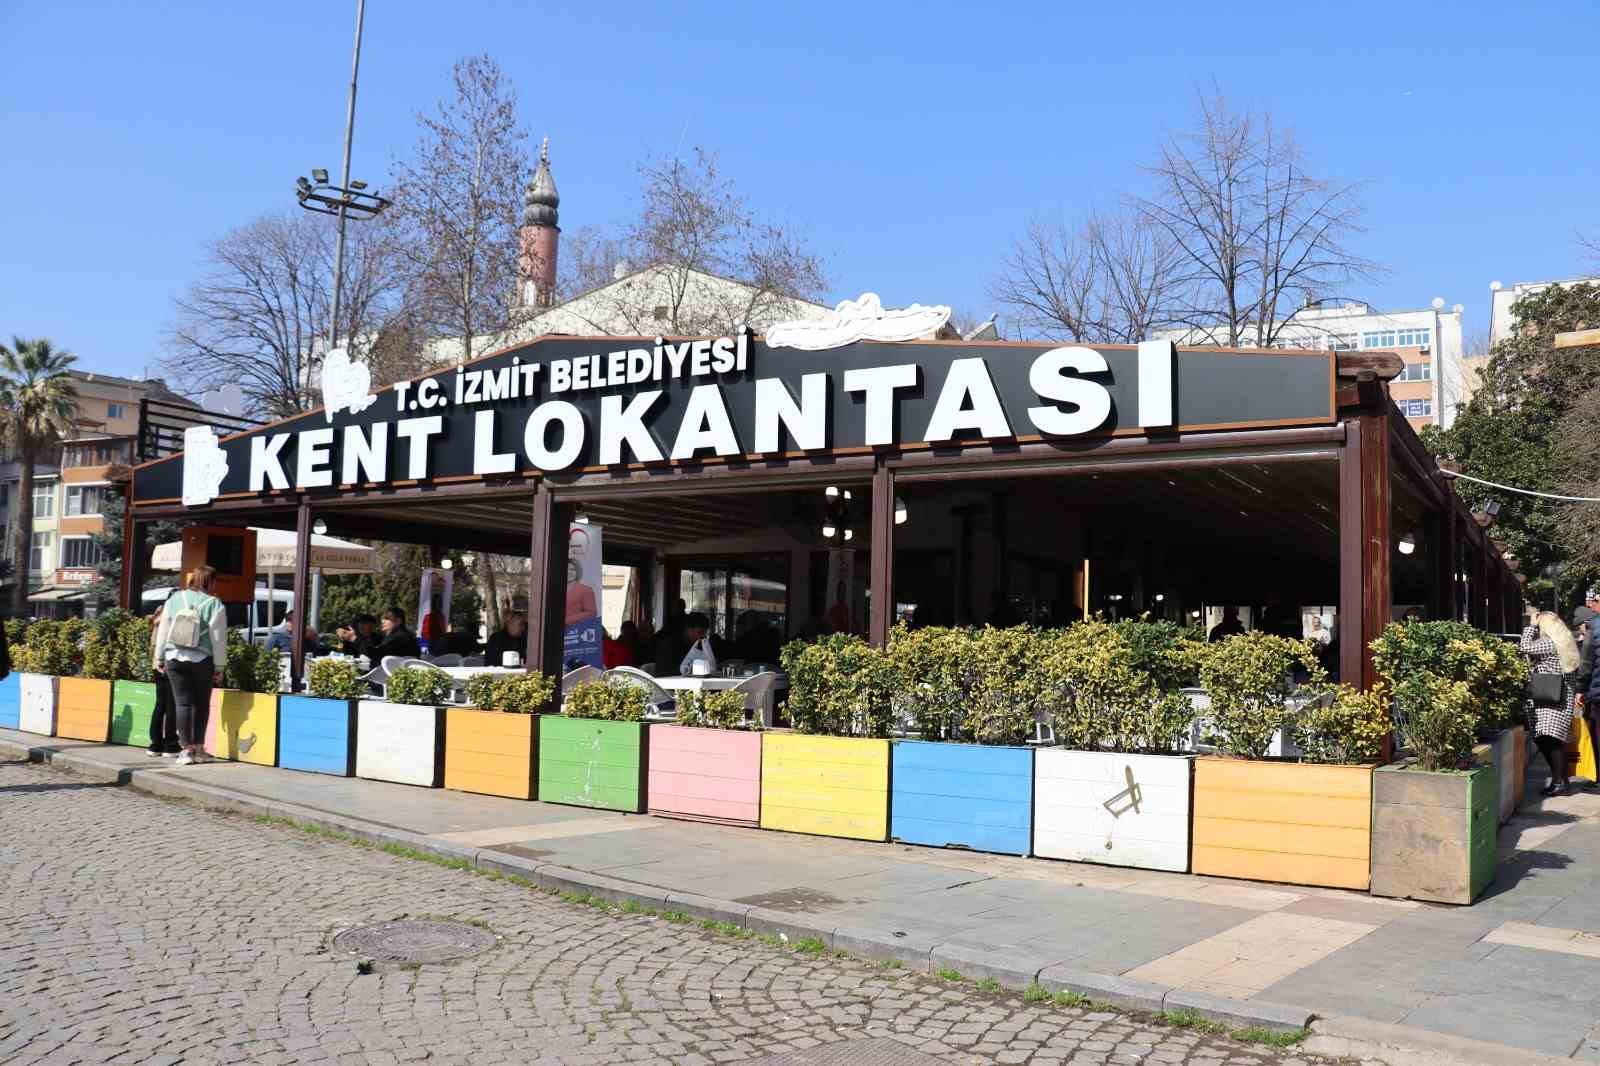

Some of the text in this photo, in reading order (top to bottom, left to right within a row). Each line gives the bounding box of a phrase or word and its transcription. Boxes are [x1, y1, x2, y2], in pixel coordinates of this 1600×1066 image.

[249, 339, 1173, 492] KENT LOKANTASI
[393, 324, 748, 412] T.C. İZMİT BELEDİYESİ
